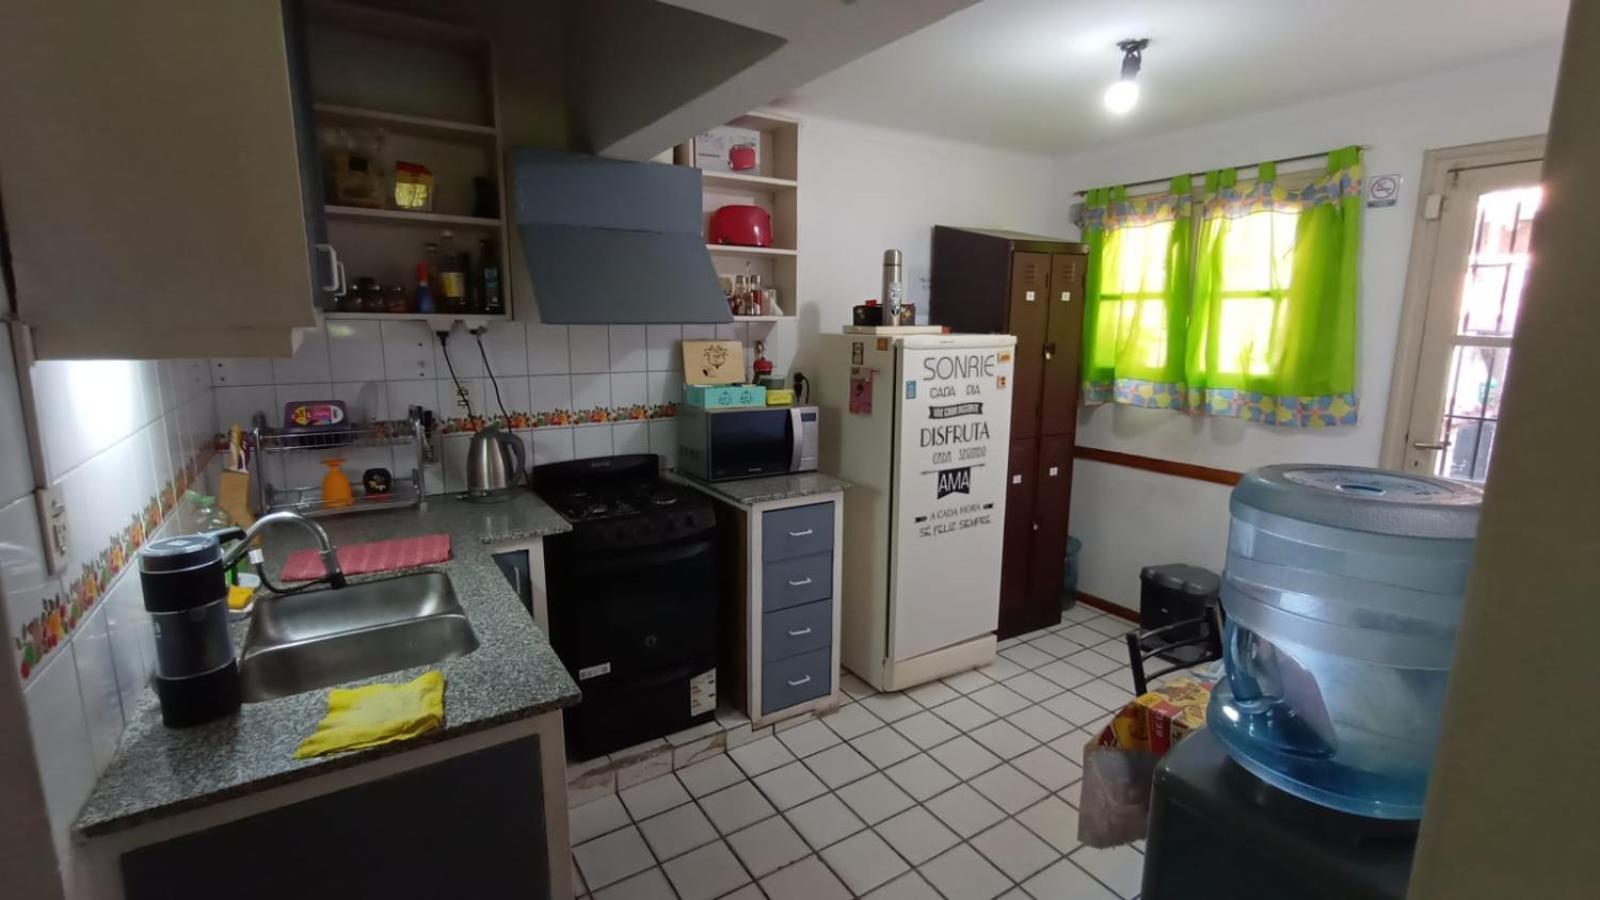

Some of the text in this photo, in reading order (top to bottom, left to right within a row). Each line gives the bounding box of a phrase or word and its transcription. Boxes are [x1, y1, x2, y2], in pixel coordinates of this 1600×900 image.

[923, 354, 995, 381] SONRIE
[929, 386, 956, 399] CADA
[920, 422, 990, 448] DISFRUTA
[938, 470, 970, 493] AMA
